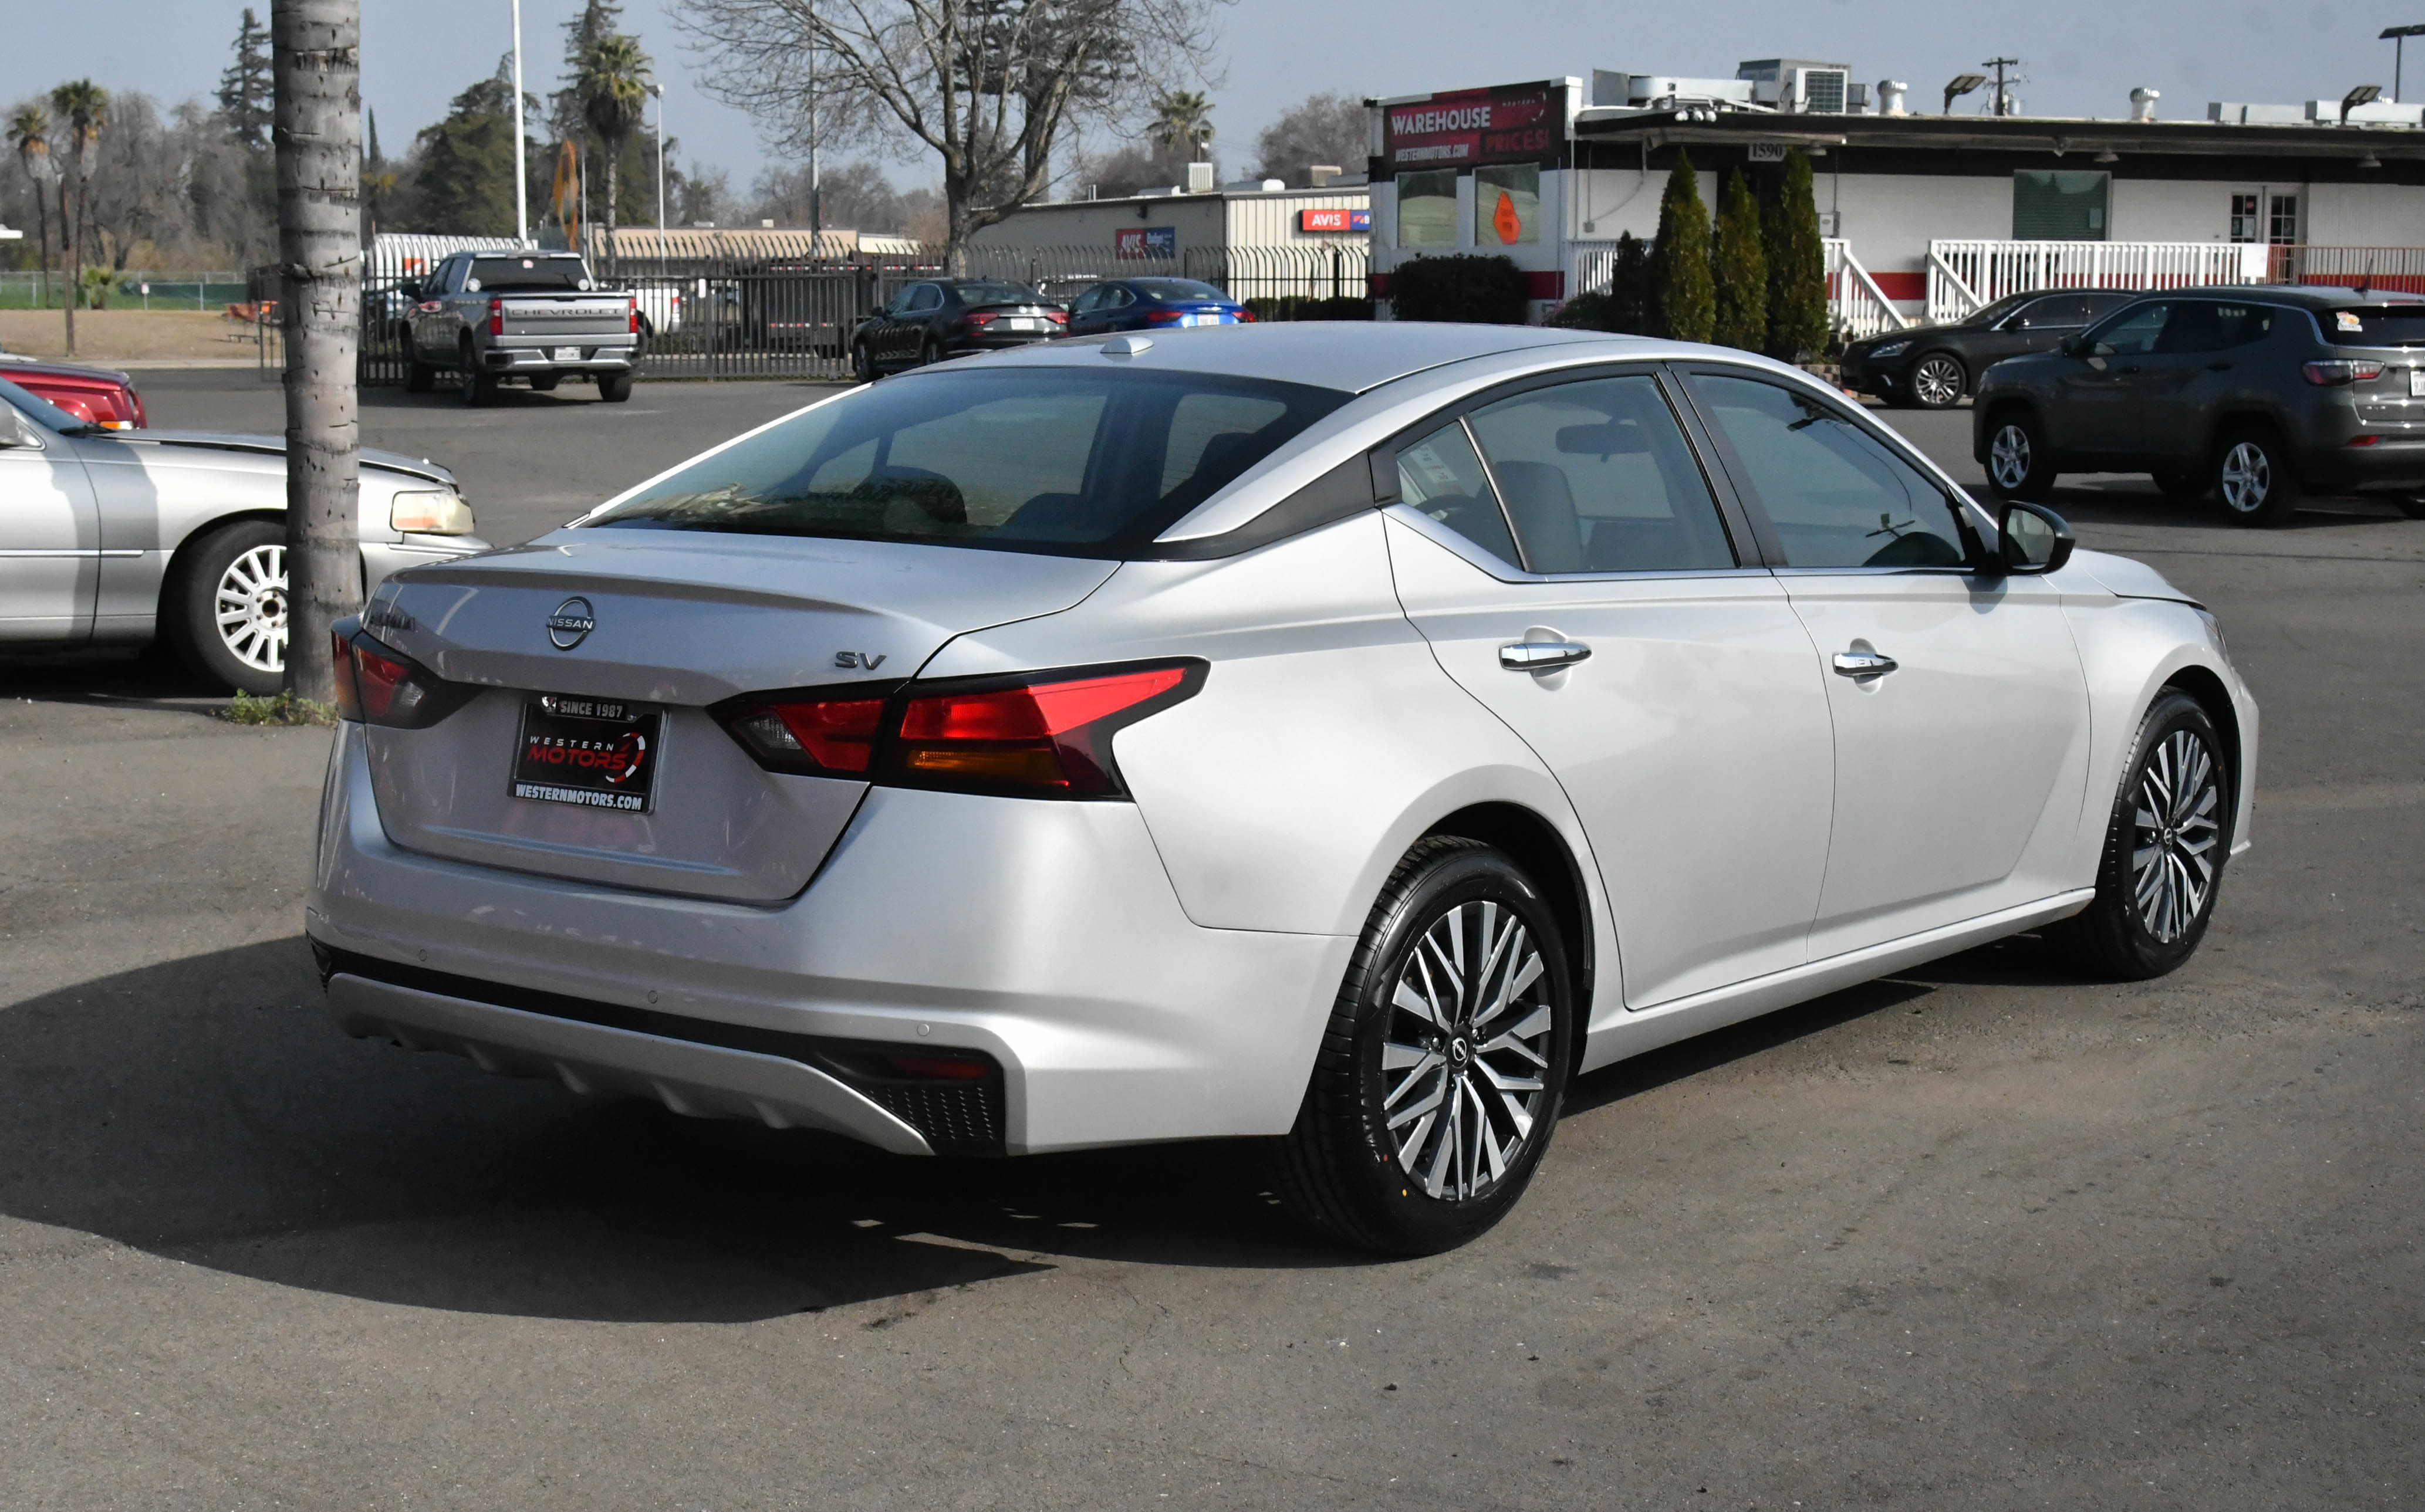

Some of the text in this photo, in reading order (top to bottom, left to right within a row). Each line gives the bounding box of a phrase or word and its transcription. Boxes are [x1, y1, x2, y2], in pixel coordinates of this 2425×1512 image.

[1391, 106, 1491, 136] WAREHOUSE
[1485, 128, 1550, 153] PRICES!
[1752, 143, 1782, 158] 1590
[1312, 214, 1342, 226] AVIS
[1122, 234, 1141, 253] AVIS
[548, 618, 593, 629] NISSAN
[835, 651, 887, 670] SV
[560, 700, 623, 718] SINCE 1987
[530, 736, 614, 752] WESTERN
[527, 745, 629, 770] MOTORS
[516, 783, 643, 811] WESTERNMOTORS.COM
